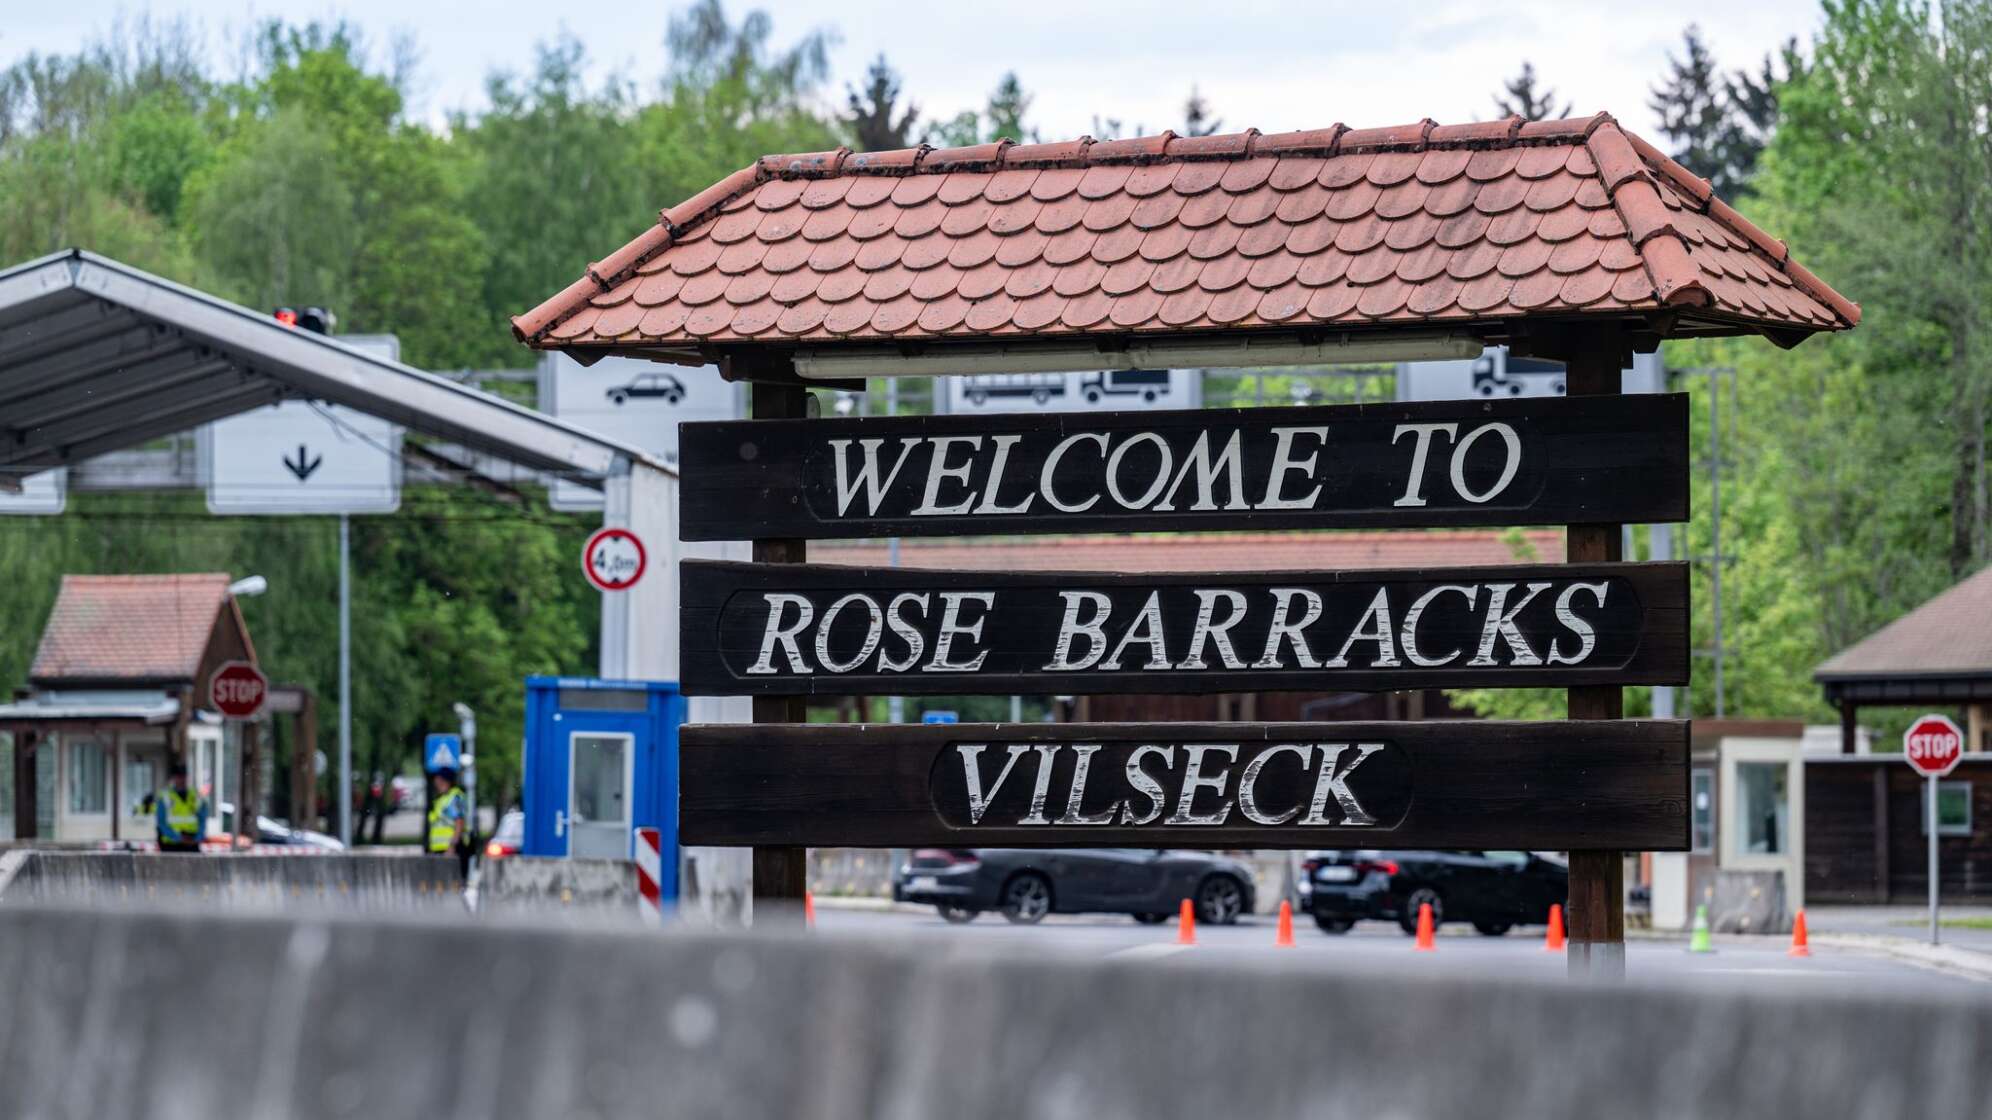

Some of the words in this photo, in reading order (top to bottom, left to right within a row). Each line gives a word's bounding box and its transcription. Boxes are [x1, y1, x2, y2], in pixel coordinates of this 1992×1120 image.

[828, 426, 1329, 517] WELCOME
[1392, 422, 1521, 508] TO
[746, 591, 996, 675] ROSE
[1042, 581, 1609, 672] BARRACKS
[214, 678, 262, 703] STOP
[956, 743, 1385, 827] VILSECK
[1910, 733, 1957, 760] STOP
